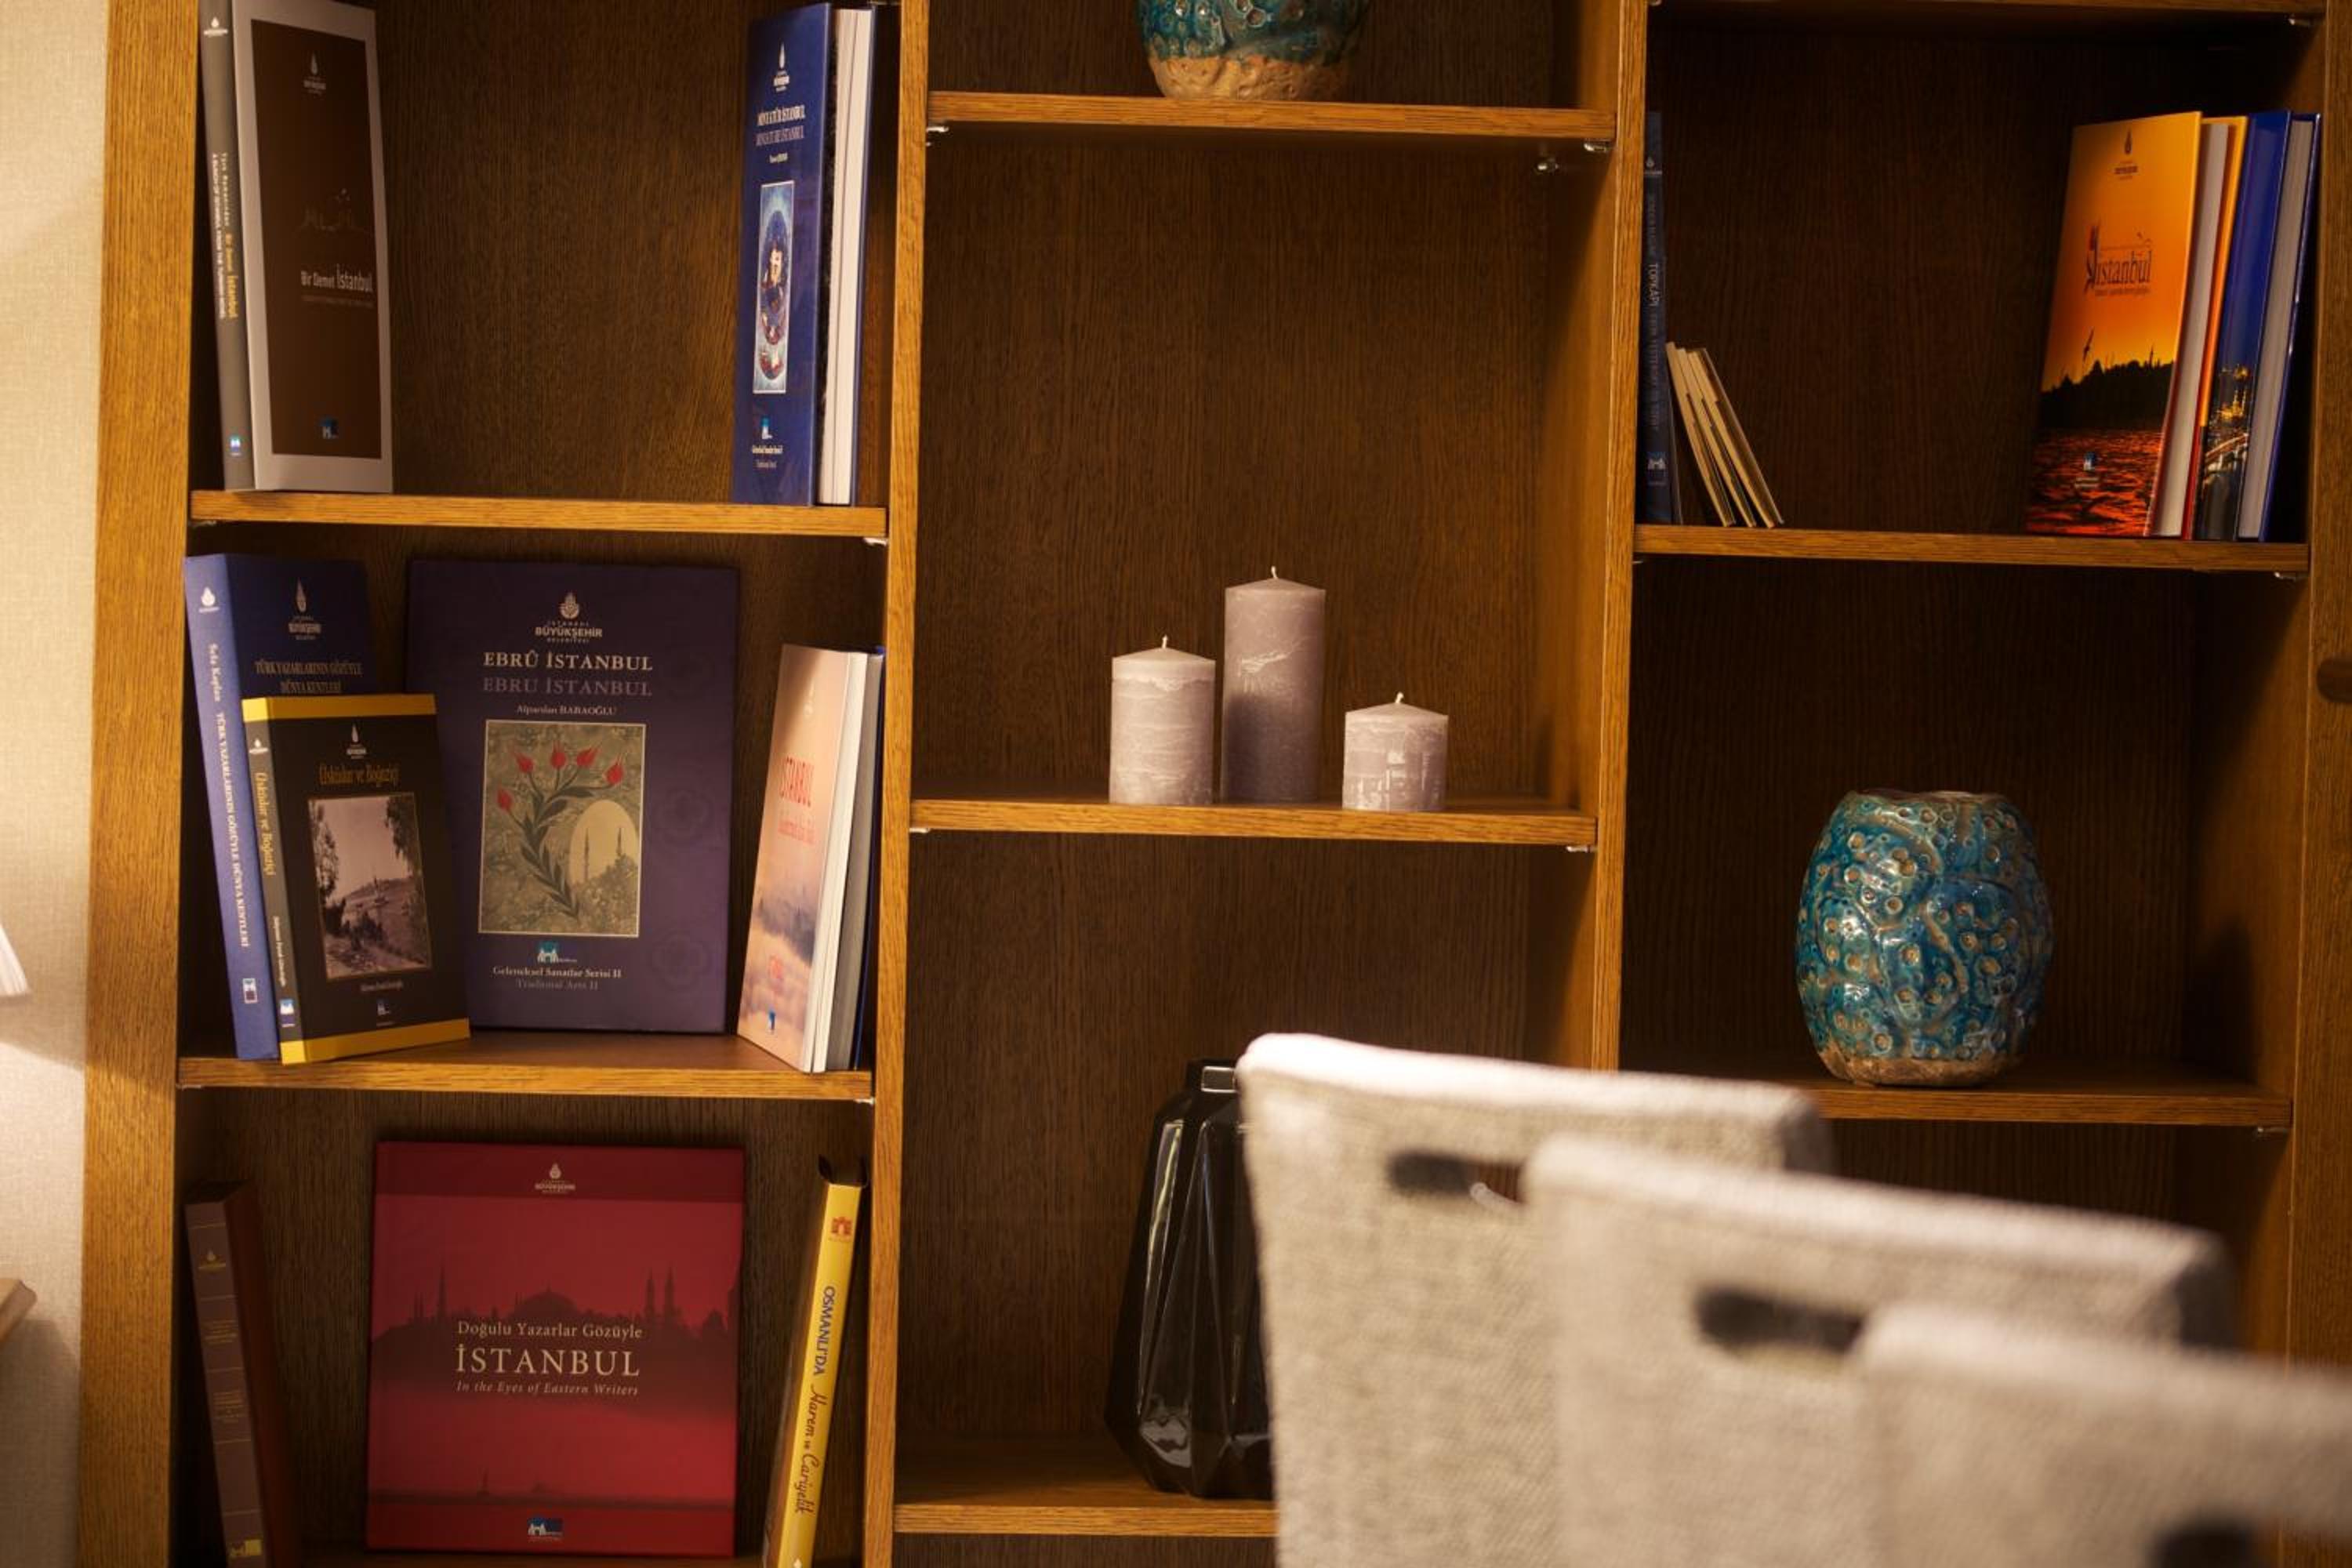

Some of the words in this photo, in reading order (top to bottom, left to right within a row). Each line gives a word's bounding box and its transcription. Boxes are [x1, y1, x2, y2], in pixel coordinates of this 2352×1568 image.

[336, 263, 372, 292] İstanbul
[534, 626, 603, 639] BÜYÜKŞEHİR
[482, 677, 539, 693] EBRU
[457, 1319, 512, 1338] Doğulu
[517, 1322, 578, 1338] Yazarlar
[582, 1324, 644, 1342] Gözüyle
[455, 1342, 641, 1377] İSTANBUL
[456, 1380, 470, 1393] In
[474, 1381, 494, 1393] the
[497, 1381, 524, 1396] Eyes
[528, 1382, 541, 1396] of
[543, 1383, 589, 1395] Eastern
[594, 1383, 639, 1397] Writers
[804, 1383, 828, 1437] Harem
